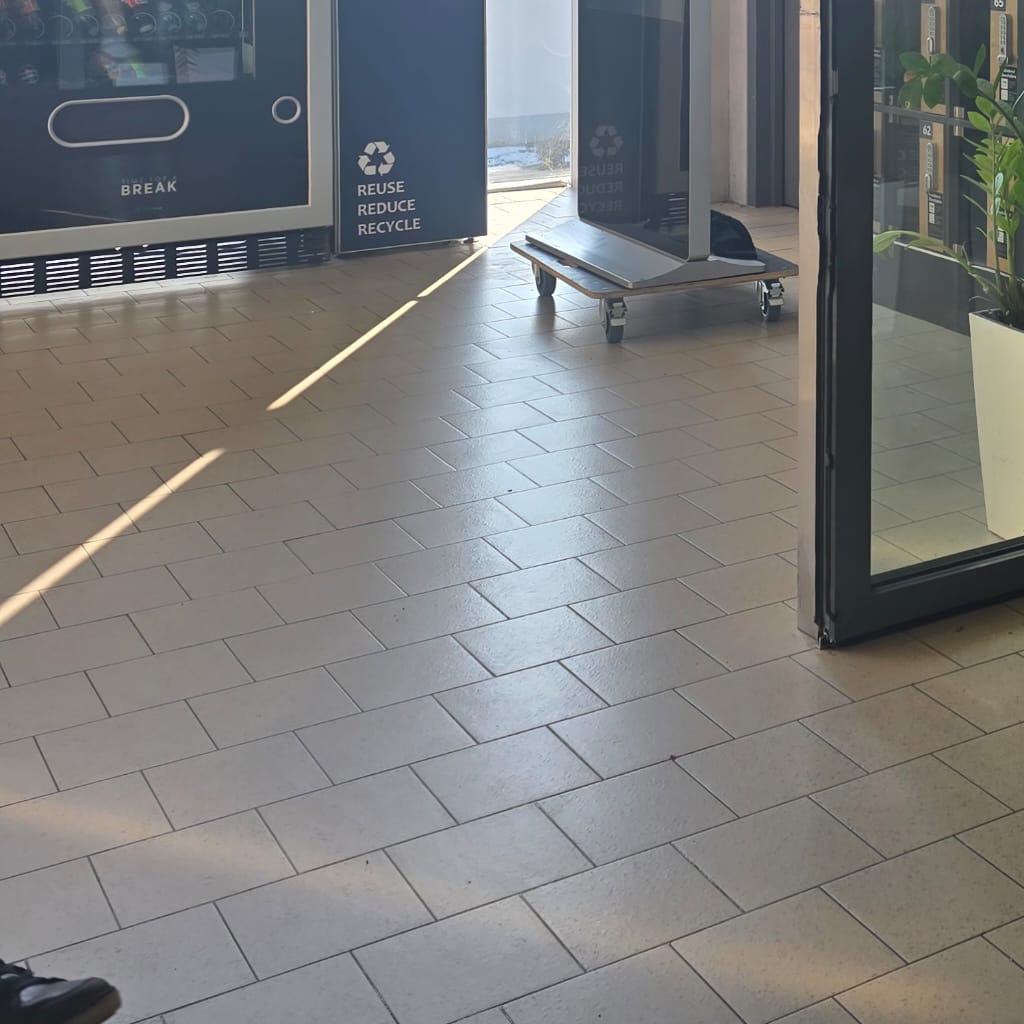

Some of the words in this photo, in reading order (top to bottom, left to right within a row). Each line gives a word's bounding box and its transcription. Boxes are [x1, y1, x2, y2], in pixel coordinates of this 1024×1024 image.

[922, 124, 931, 136] 62
[121, 180, 177, 196] BREAK
[357, 181, 405, 197] REUSE
[357, 199, 416, 217] REDUCE
[357, 218, 421, 236] RECYCLE
